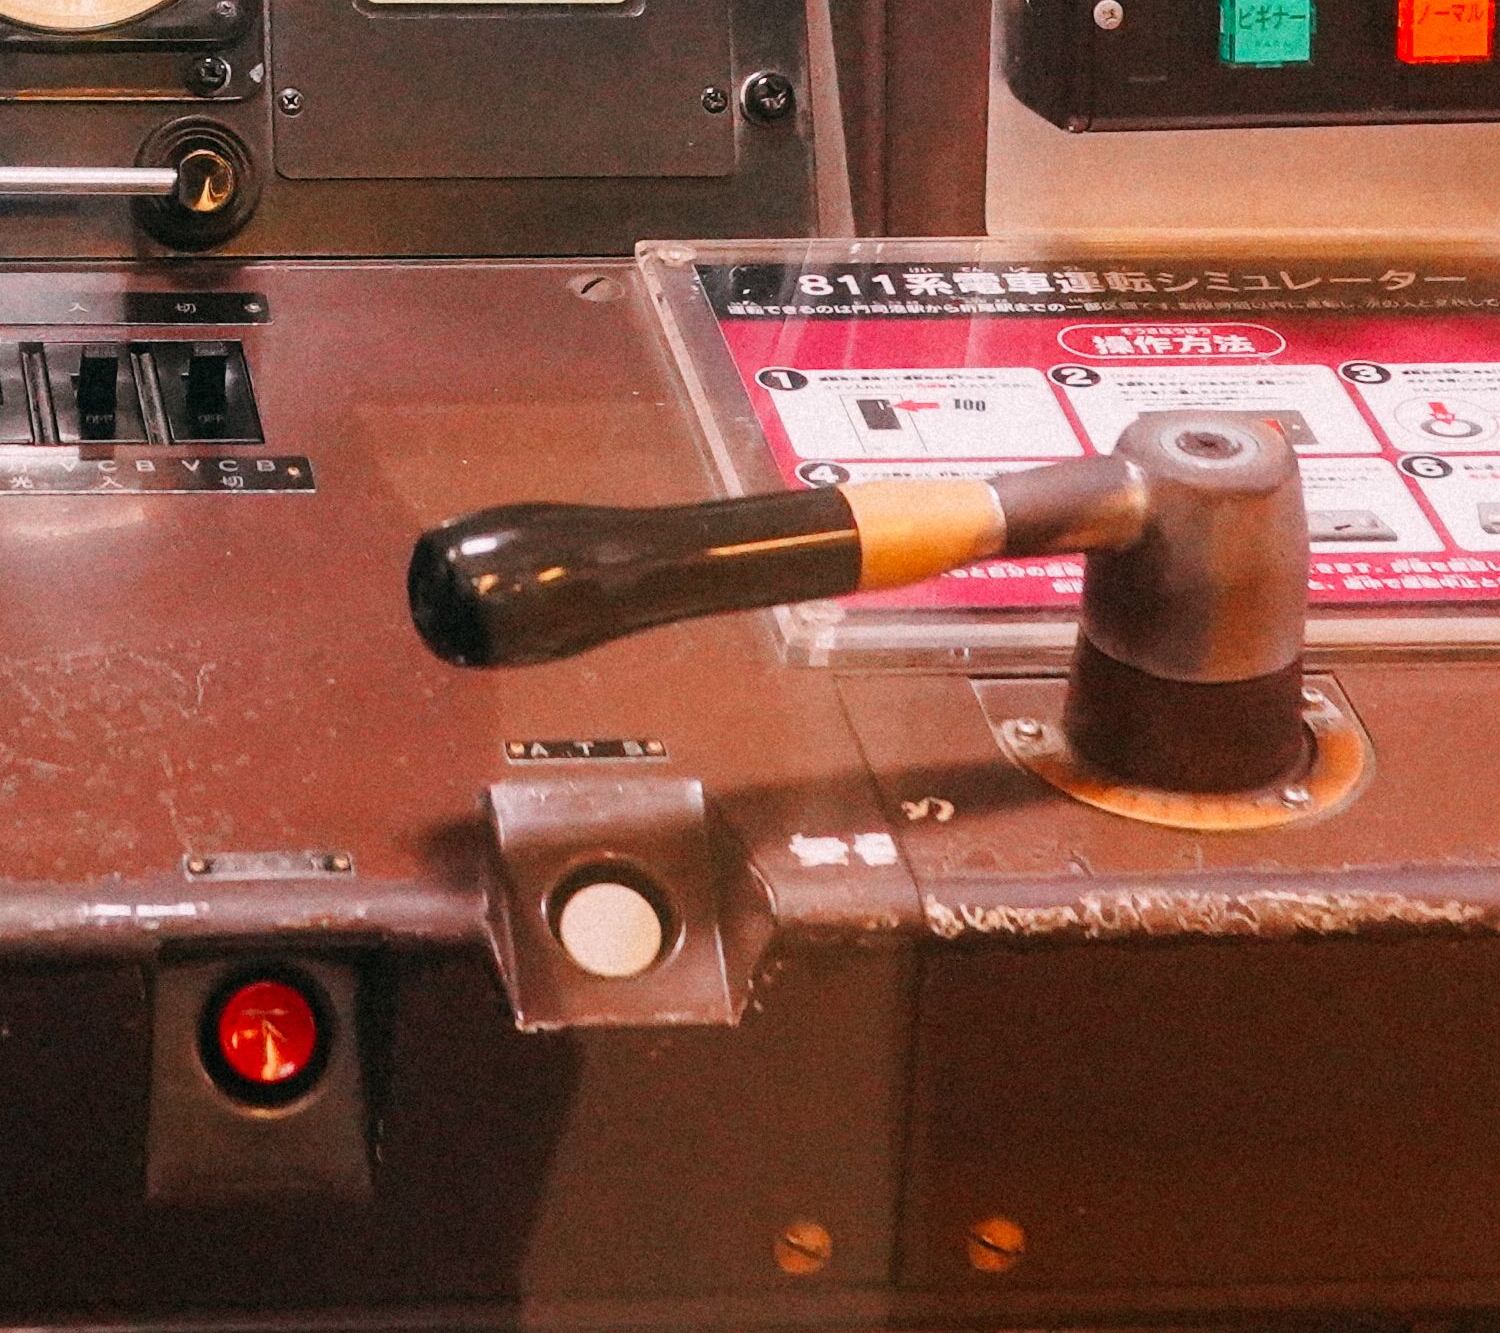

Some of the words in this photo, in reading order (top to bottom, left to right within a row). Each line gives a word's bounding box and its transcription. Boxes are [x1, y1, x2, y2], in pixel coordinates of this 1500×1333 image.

[1238, 4, 1307, 31] ビギナー
[1417, 3, 1485, 26] ノーマル
[799, 271, 1467, 296] 811系電車運転シミュレーター
[175, 301, 198, 315] 切
[1091, 335, 1257, 355] 操作方法
[219, 475, 245, 489] 切
